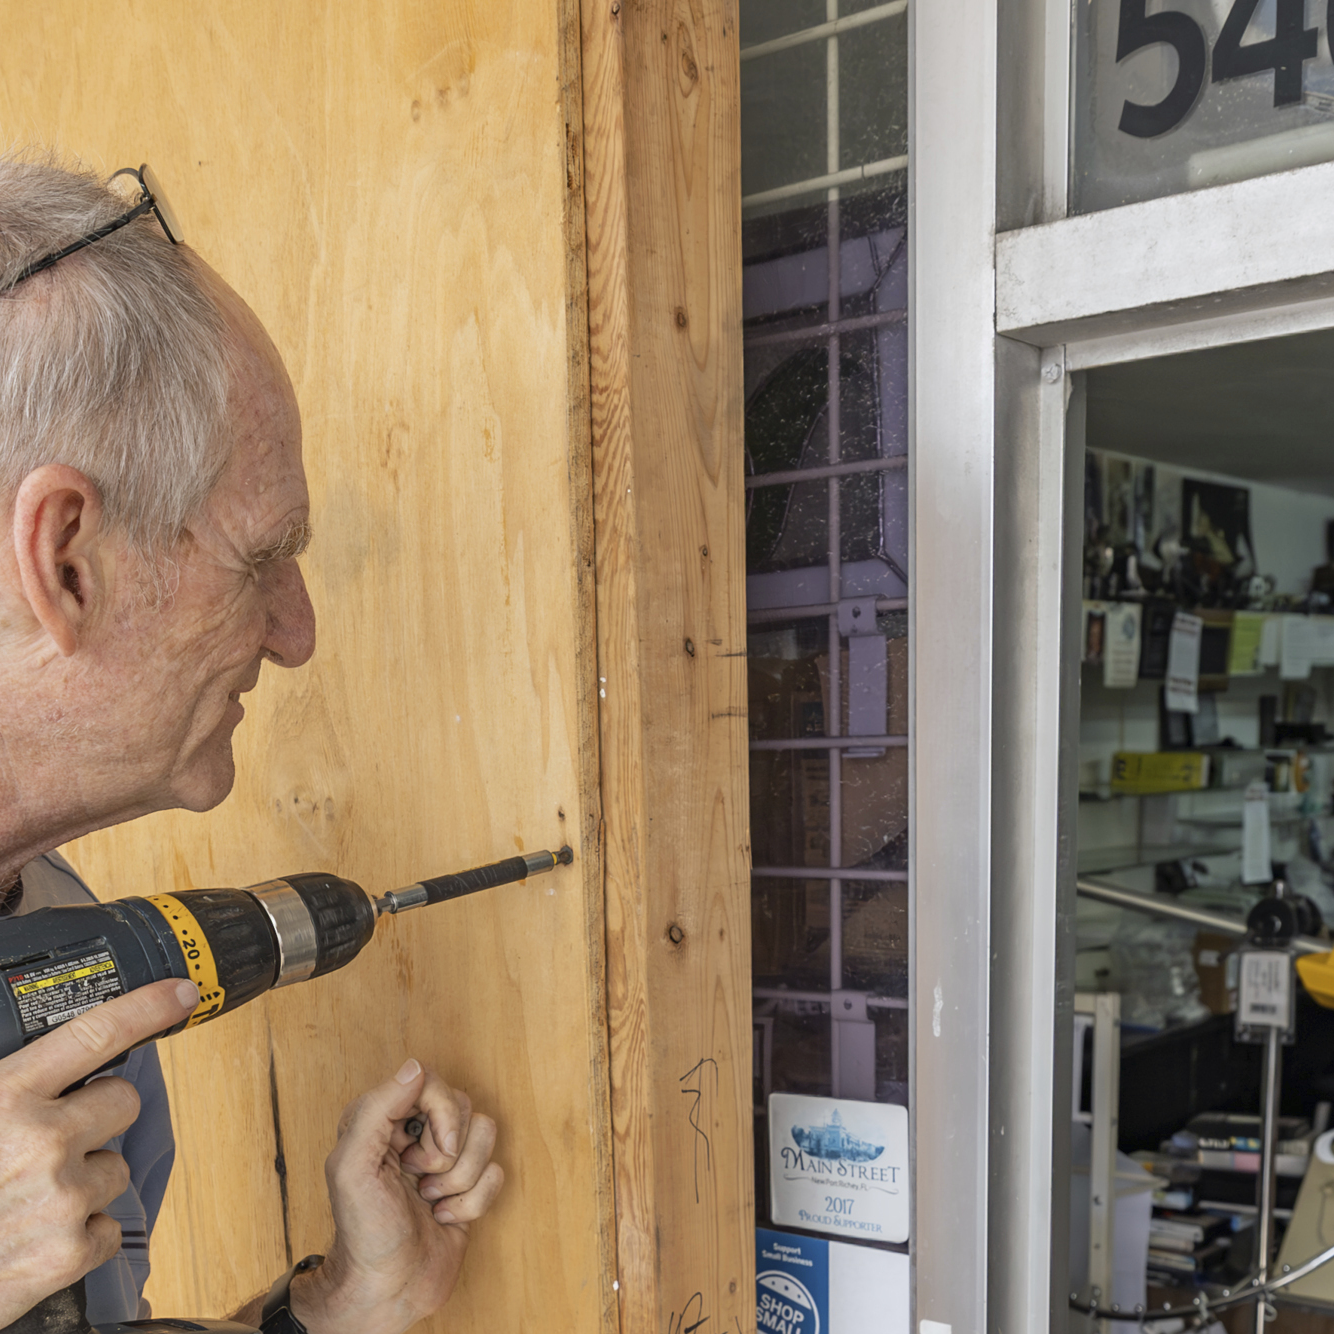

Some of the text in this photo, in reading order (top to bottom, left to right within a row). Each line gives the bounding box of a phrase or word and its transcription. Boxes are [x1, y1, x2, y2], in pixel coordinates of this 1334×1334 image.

[182, 938, 200, 960] 20
[825, 1196, 855, 1215] 2017
[762, 1249, 814, 1267] Small Business
[773, 1242, 802, 1256] Support
[760, 1293, 805, 1325] SHOP
